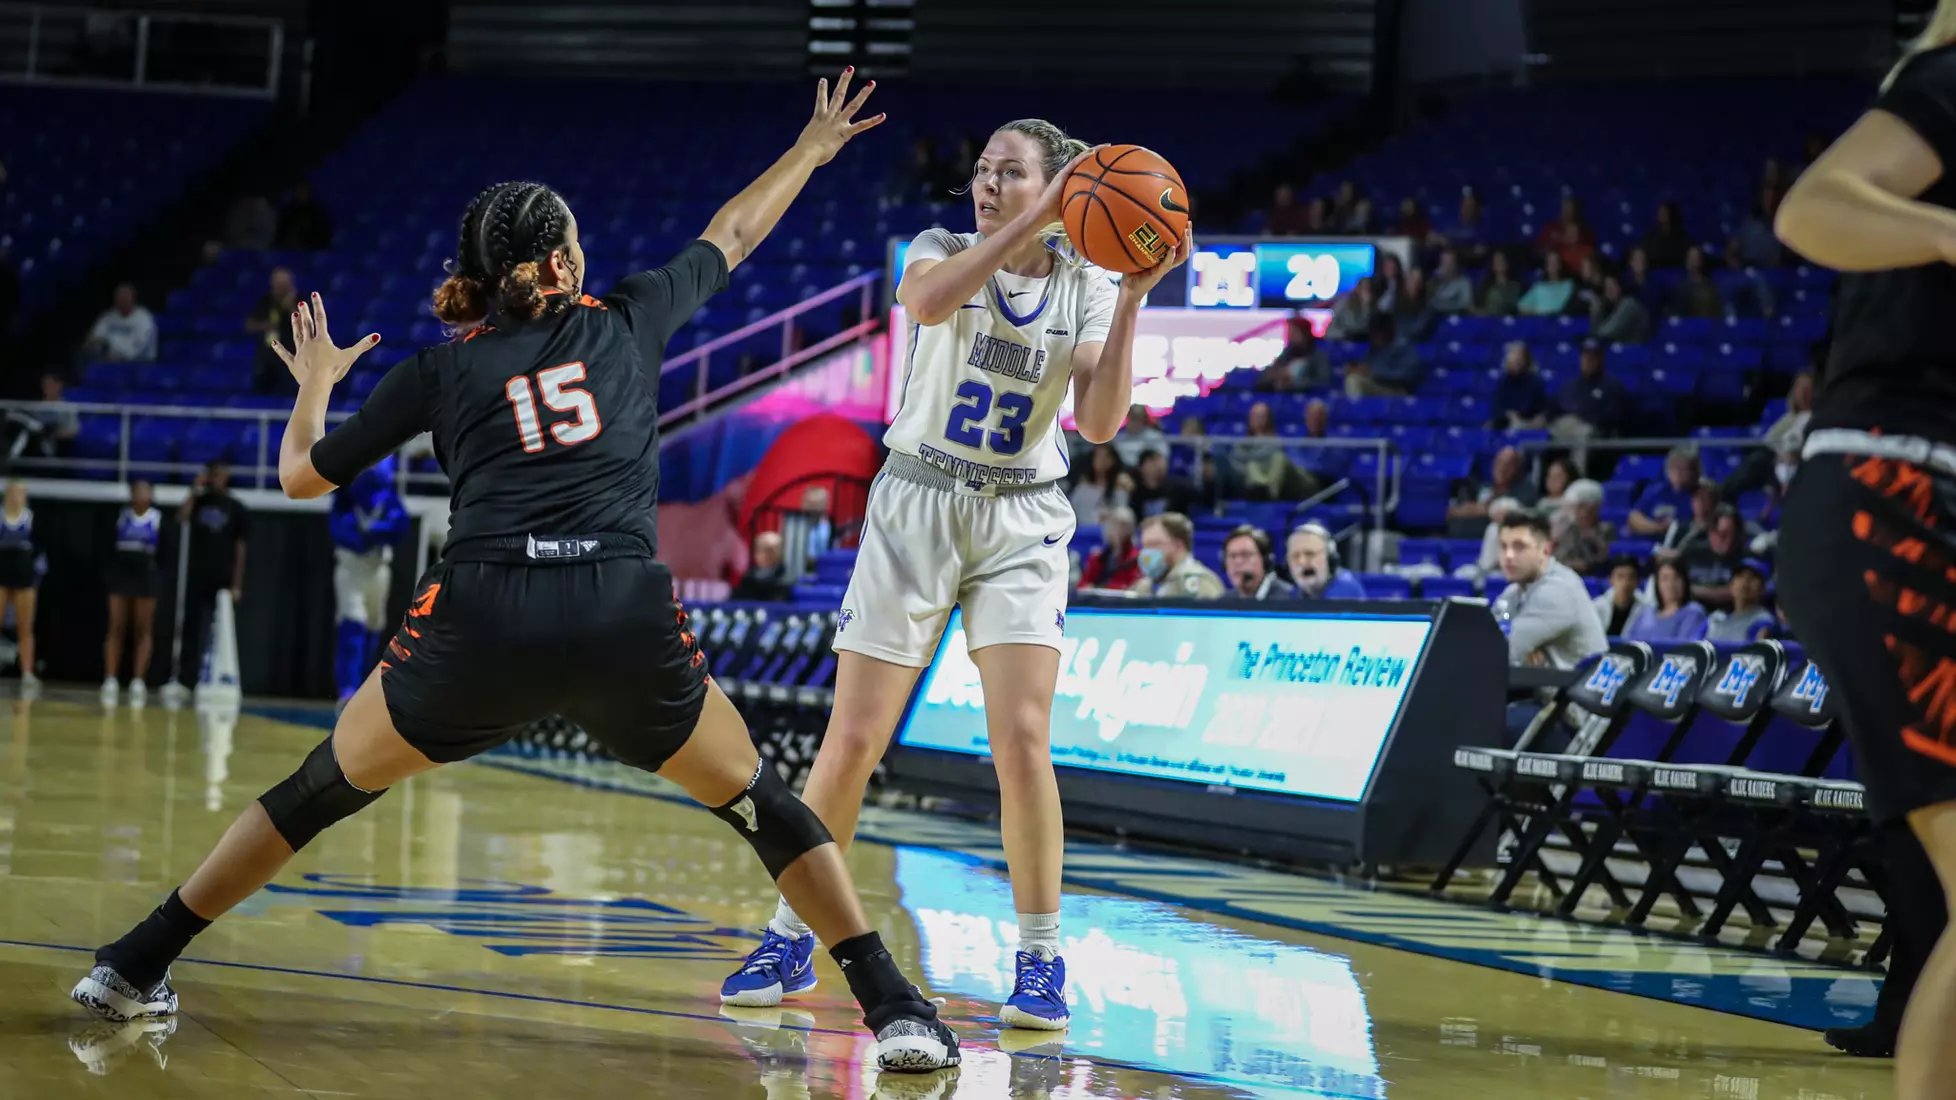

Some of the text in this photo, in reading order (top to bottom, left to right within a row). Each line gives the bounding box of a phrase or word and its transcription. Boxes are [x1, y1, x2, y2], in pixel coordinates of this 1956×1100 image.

[1133, 221, 1171, 261] ELIT
[968, 332, 1046, 384] MIDDLE
[506, 361, 601, 453] 15
[944, 379, 1035, 456] 23
[919, 443, 1037, 485] TENNESSEE
[1341, 645, 1408, 687] Review
[1585, 656, 1626, 706] MT
[1648, 657, 1690, 708] MT
[1716, 657, 1759, 708] MT
[1814, 788, 1863, 809] BLUE RAIDERS
